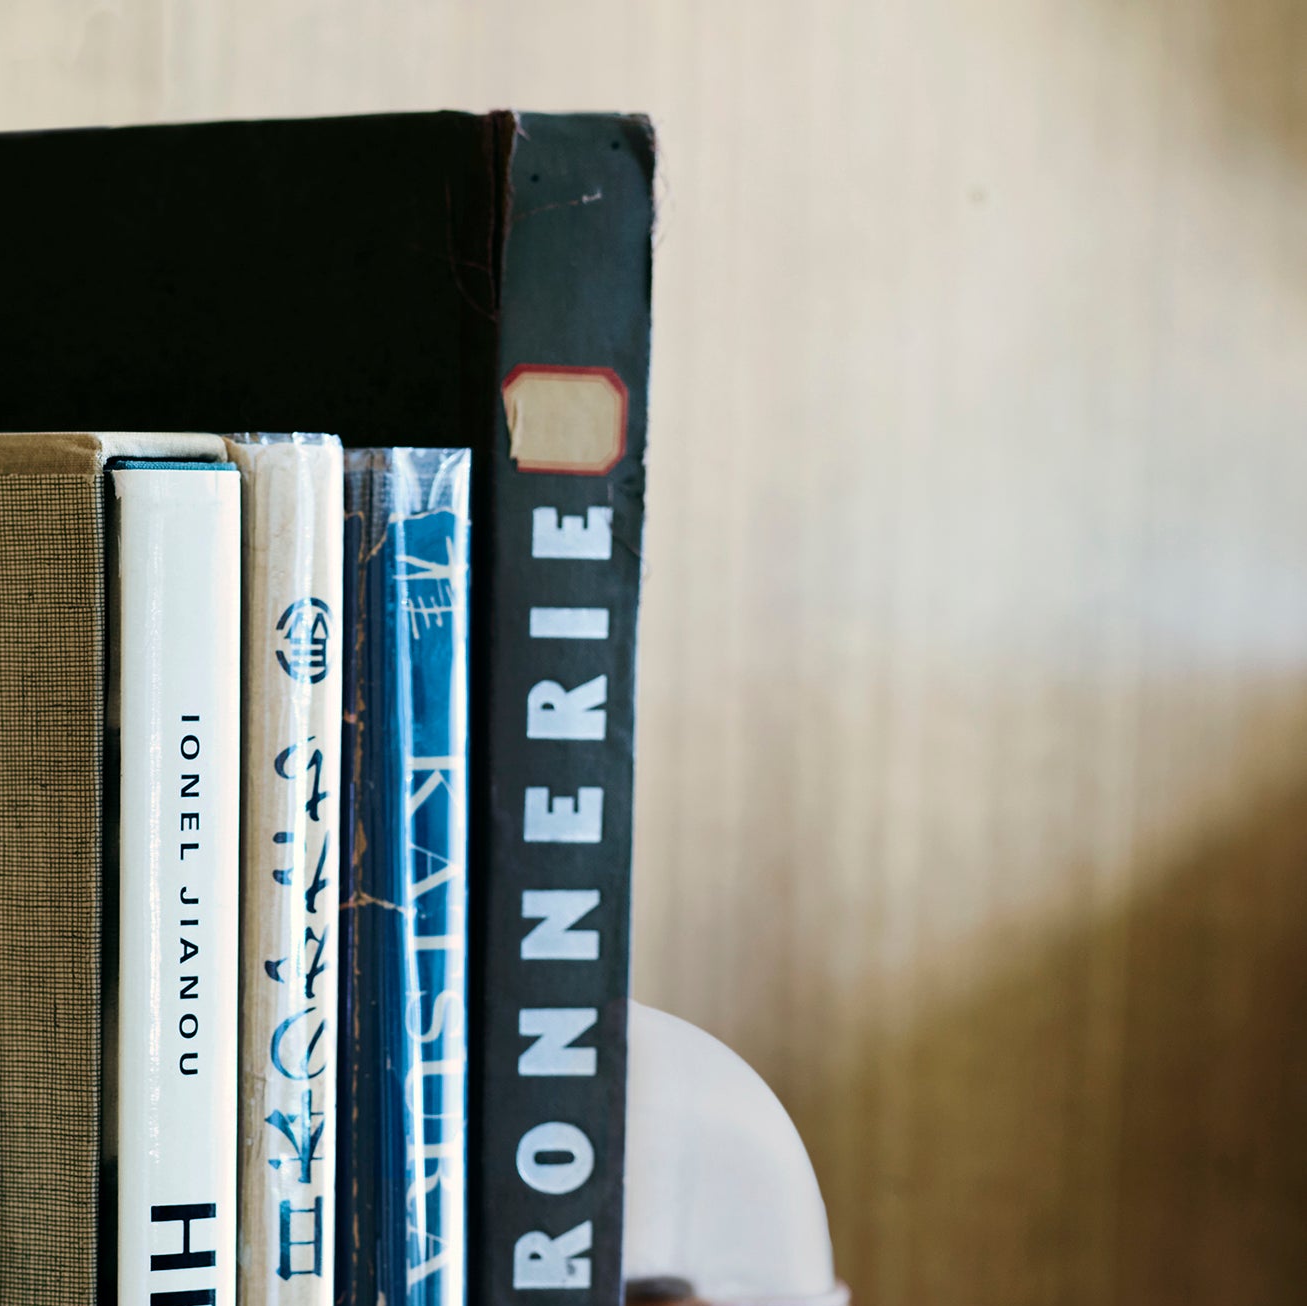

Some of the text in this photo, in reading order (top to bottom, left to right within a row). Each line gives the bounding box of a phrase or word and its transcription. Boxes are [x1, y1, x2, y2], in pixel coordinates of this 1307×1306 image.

[178, 714, 200, 1076] IONEL JIANOU
[264, 735, 330, 1281] 日本のかたち
[405, 755, 467, 1287] KATSURA
